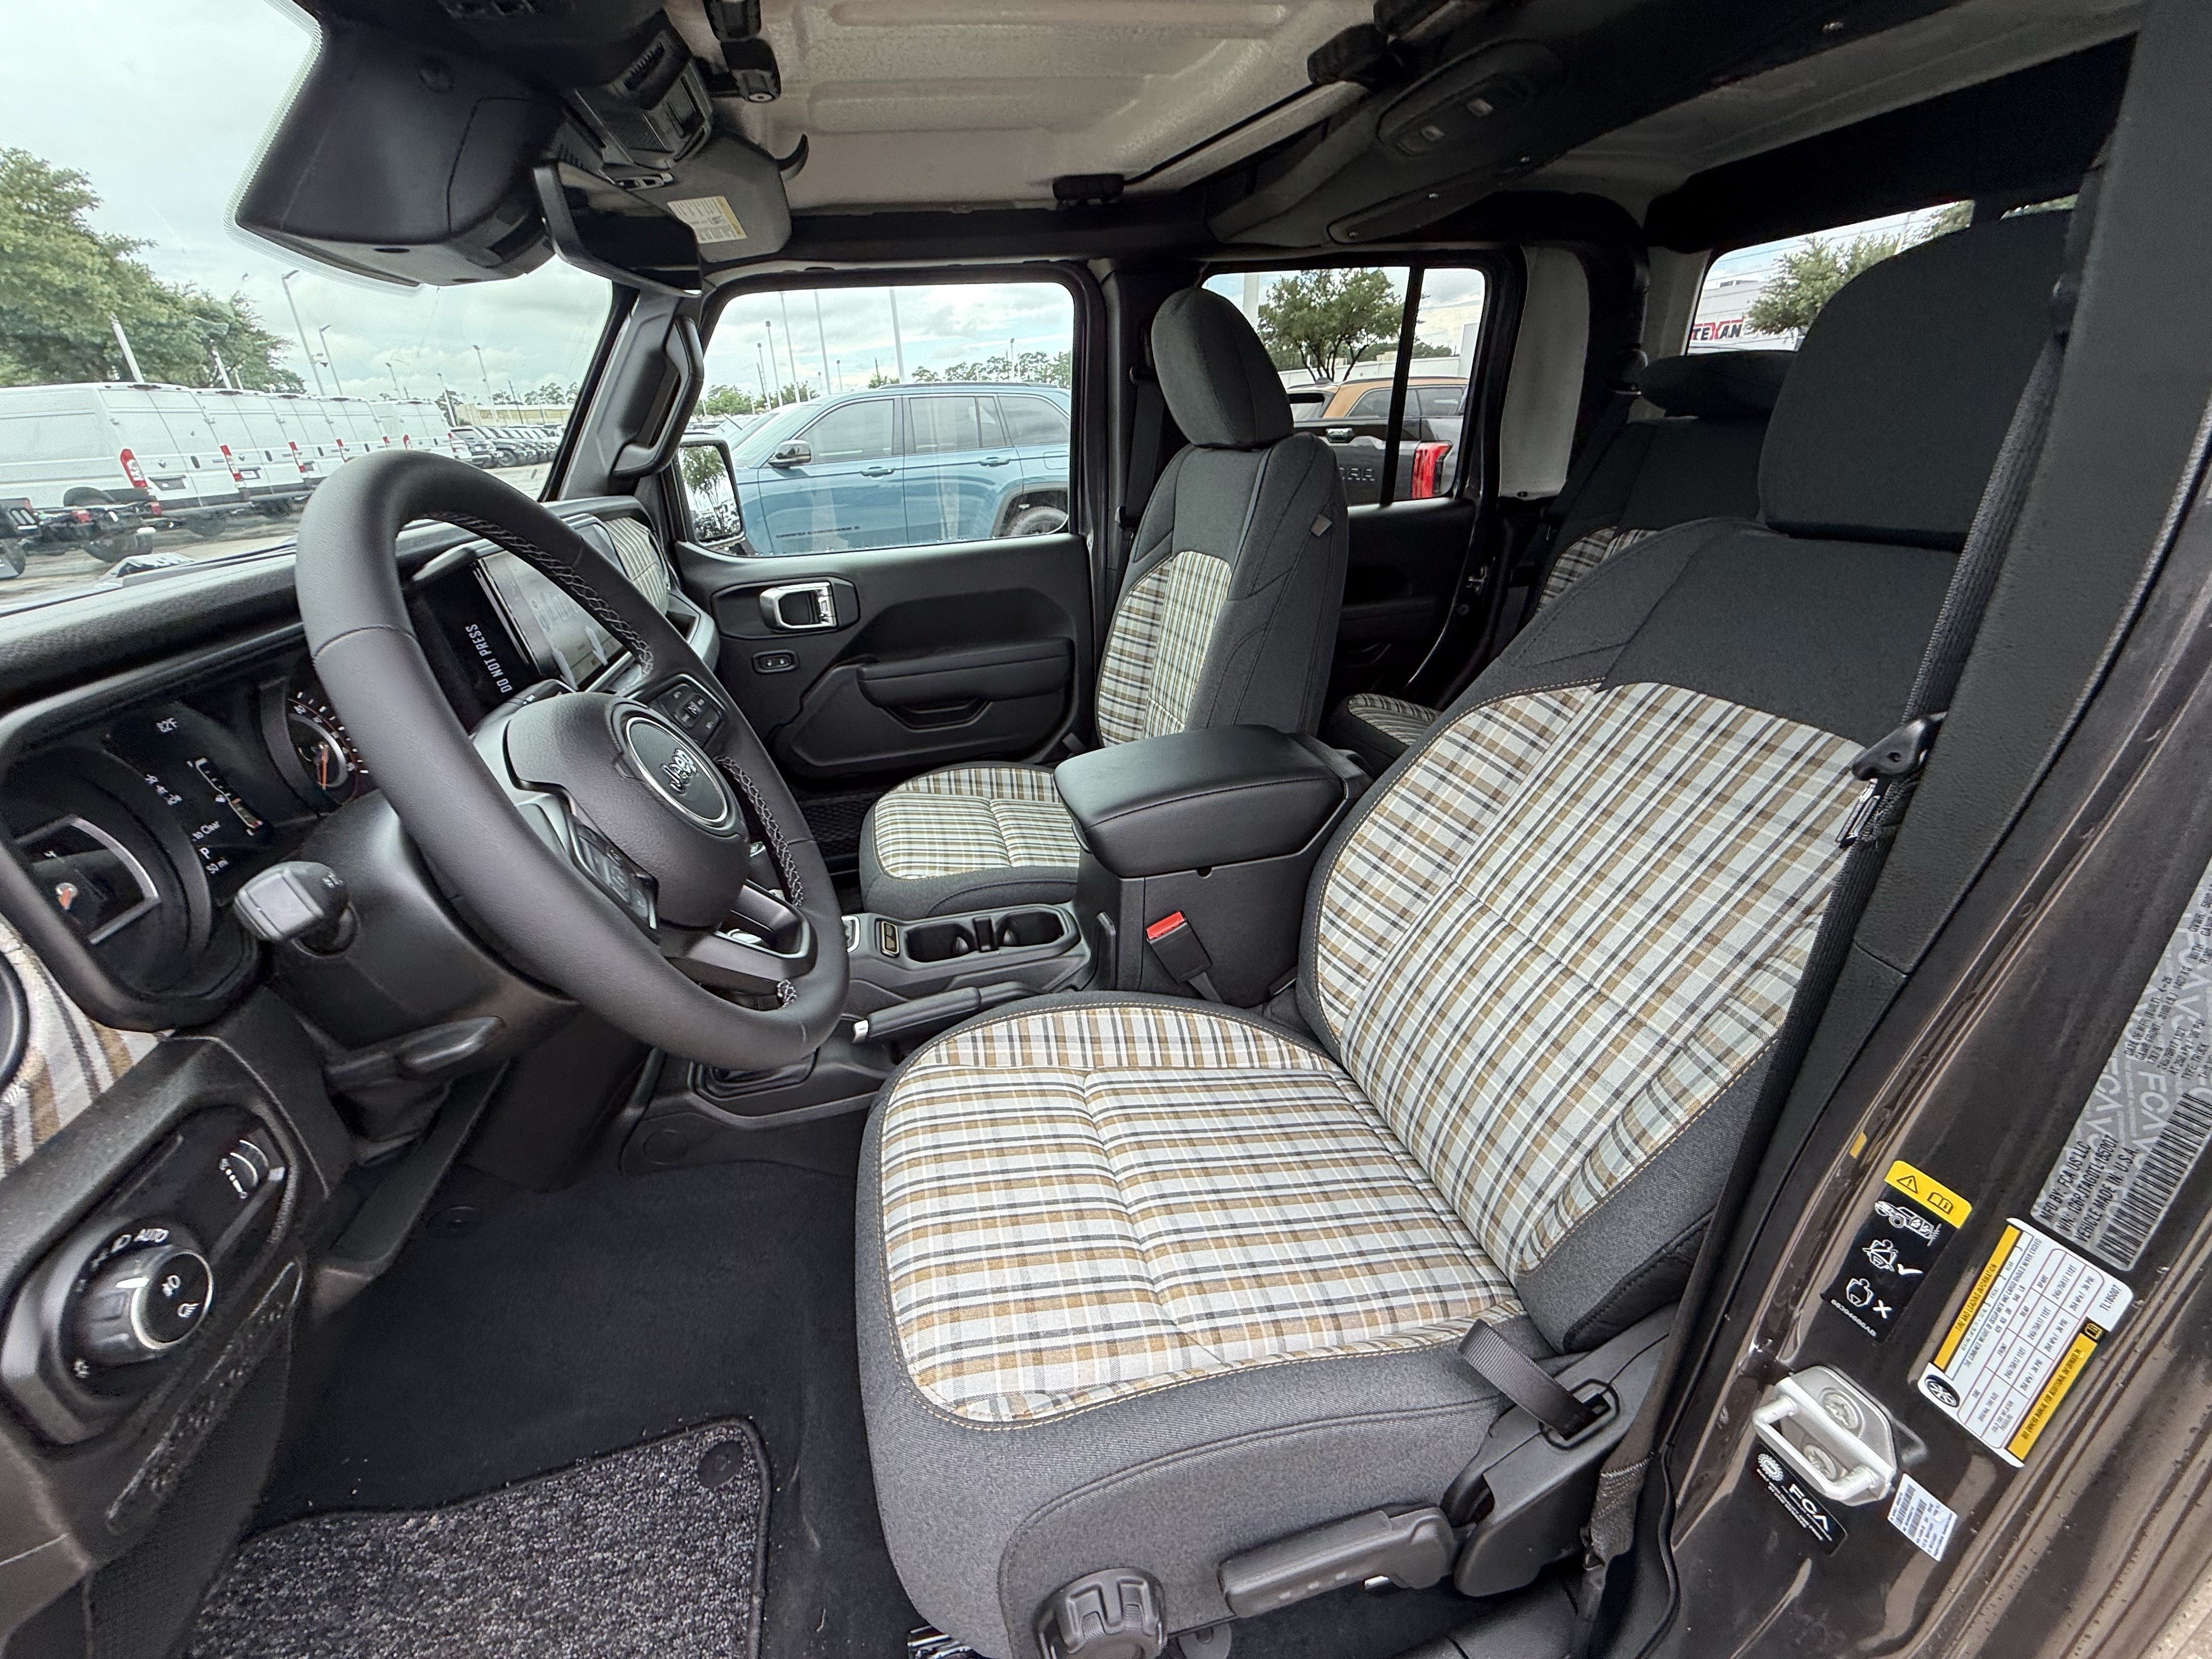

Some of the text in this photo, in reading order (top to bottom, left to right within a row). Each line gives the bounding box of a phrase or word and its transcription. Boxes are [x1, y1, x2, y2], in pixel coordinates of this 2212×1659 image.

[1692, 323, 1743, 341] TEXAN
[465, 624, 512, 693] DO NOT PRESS
[662, 749, 697, 794] Jeep
[199, 847, 211, 860] P
[2124, 1040, 2139, 1056] DATE
[2132, 1031, 2143, 1040] OF
[2135, 1042, 2151, 1060] GAWR
[2191, 1042, 2209, 1063] TRUCK
[2073, 1141, 2091, 1159] LLC
[2066, 1156, 2083, 1171] US
[2056, 1170, 2076, 1188] FCA
[2075, 1208, 2103, 1242] VEHICLE
[2093, 1184, 2116, 1210] MADE
[2113, 1148, 2139, 1172] U.S.A.
[2040, 1201, 2058, 1222] MFD
[2057, 1214, 2075, 1232] VIN:
[133, 1228, 169, 1243] AUTO
[2100, 1284, 2121, 1311] TL185007
[1789, 1483, 1829, 1532] FCA
